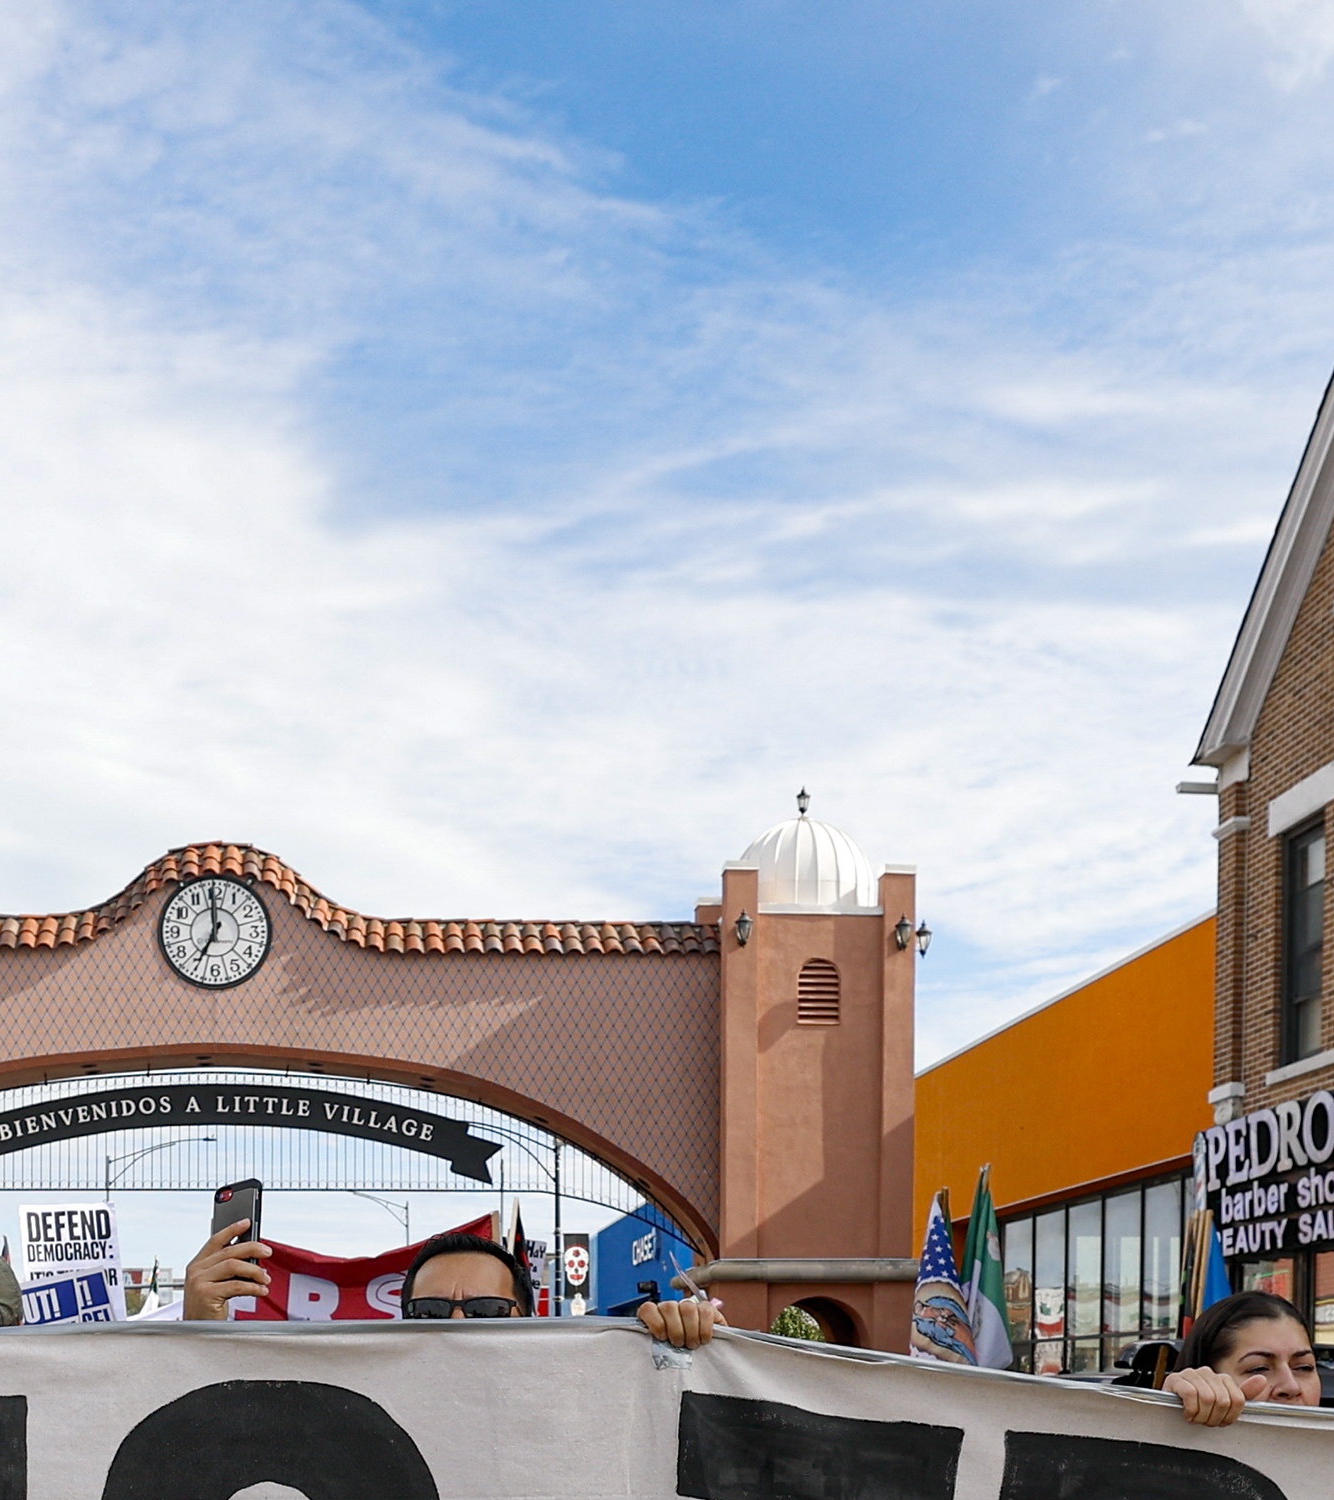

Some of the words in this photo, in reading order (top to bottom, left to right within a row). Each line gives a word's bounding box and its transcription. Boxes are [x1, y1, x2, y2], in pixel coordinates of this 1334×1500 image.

[191, 892, 200, 906] 11
[232, 892, 236, 905] 1
[176, 906, 188, 919] 10
[243, 905, 253, 918] 2
[170, 925, 180, 939] 9
[249, 925, 259, 938] 3
[176, 945, 186, 959] 8
[243, 945, 253, 958] 4
[210, 964, 221, 977] 6
[230, 959, 240, 972] 5
[185, 1098, 202, 1113] A
[215, 1095, 311, 1117] LITTLE
[322, 1101, 435, 1142] VILLAGE
[1220, 1180, 1289, 1225] barber
[27, 1209, 112, 1243] DEFEND
[1217, 1217, 1288, 1257] EAUTY
[27, 1240, 114, 1263] DEMOCRACY:
